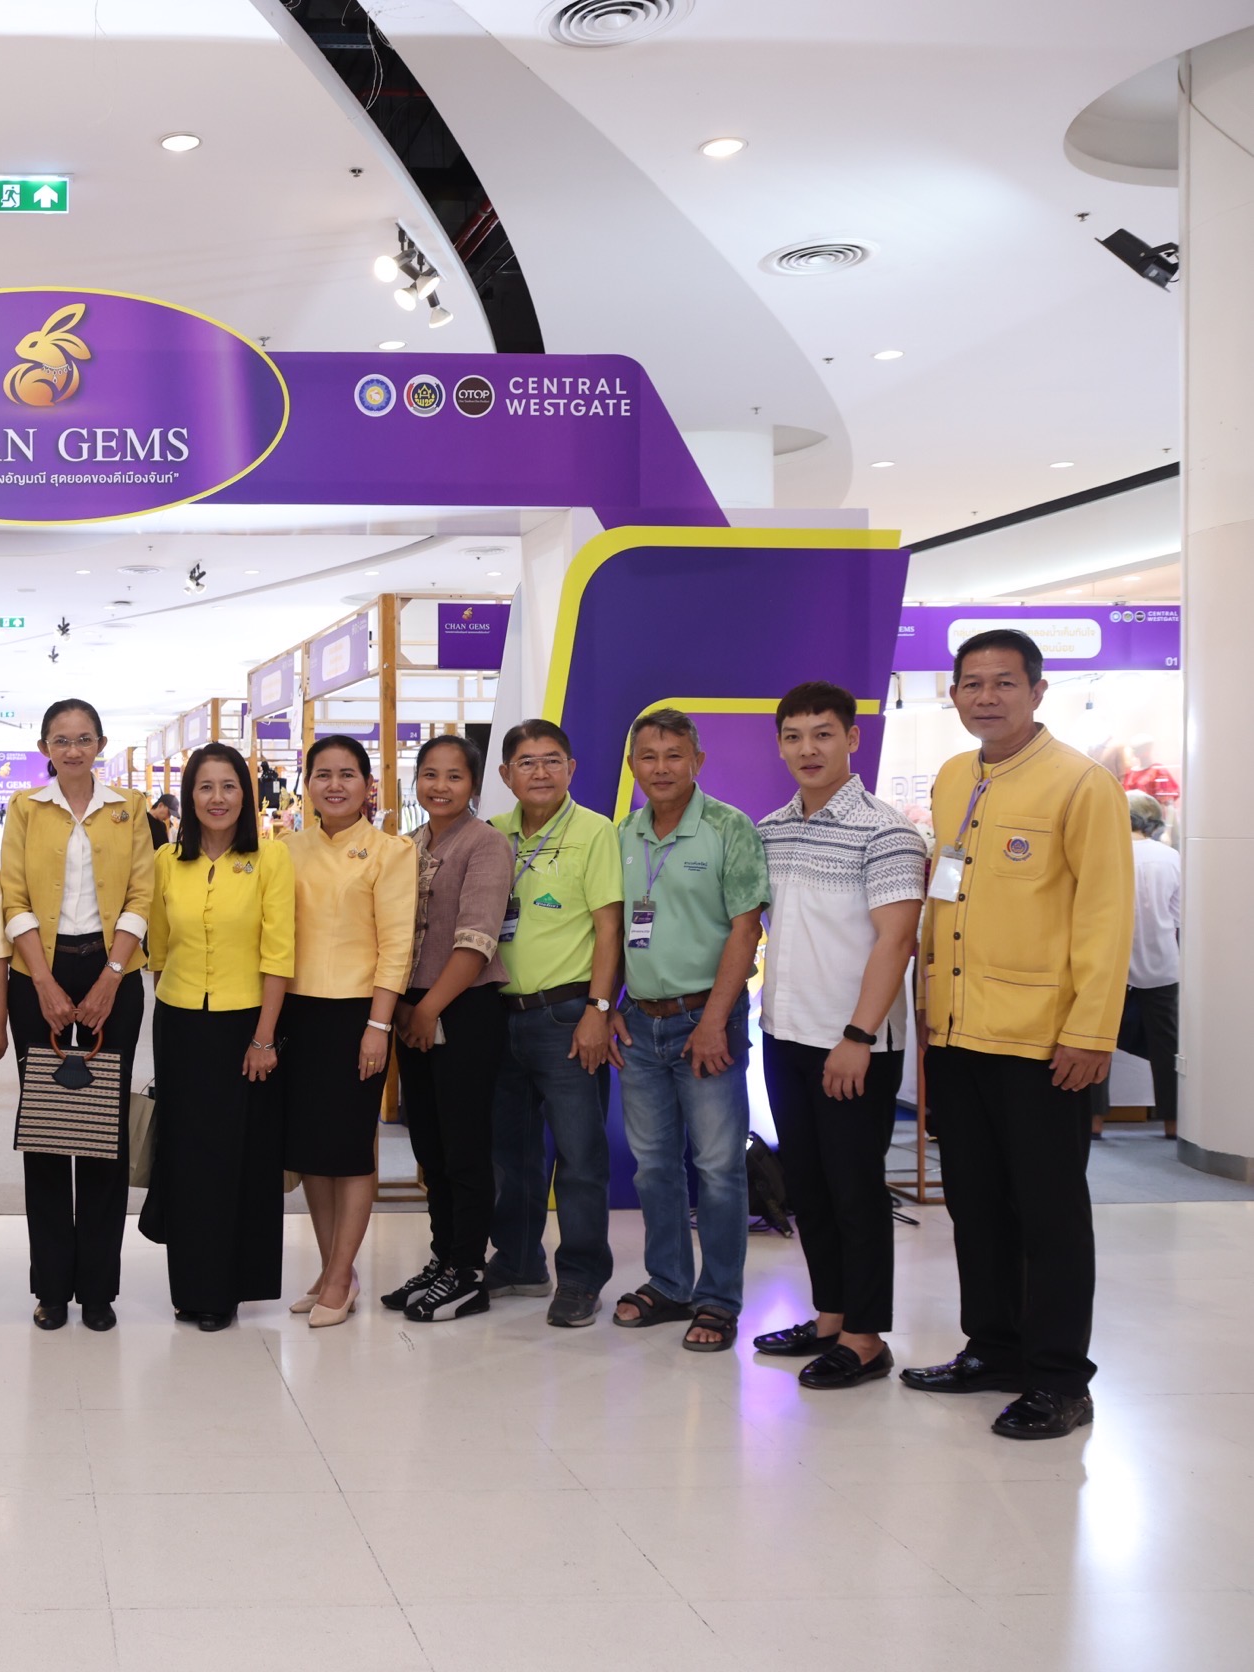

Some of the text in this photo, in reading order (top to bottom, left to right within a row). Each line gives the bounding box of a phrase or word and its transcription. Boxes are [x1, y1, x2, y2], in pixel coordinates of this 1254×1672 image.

[509, 377, 626, 395] CENTRAL
[458, 389, 490, 399] OTOP
[506, 399, 631, 416] WESTGATE
[58, 427, 189, 461] GEMS
[1165, 657, 1178, 666] 01
[6, 781, 32, 789] GEMS
